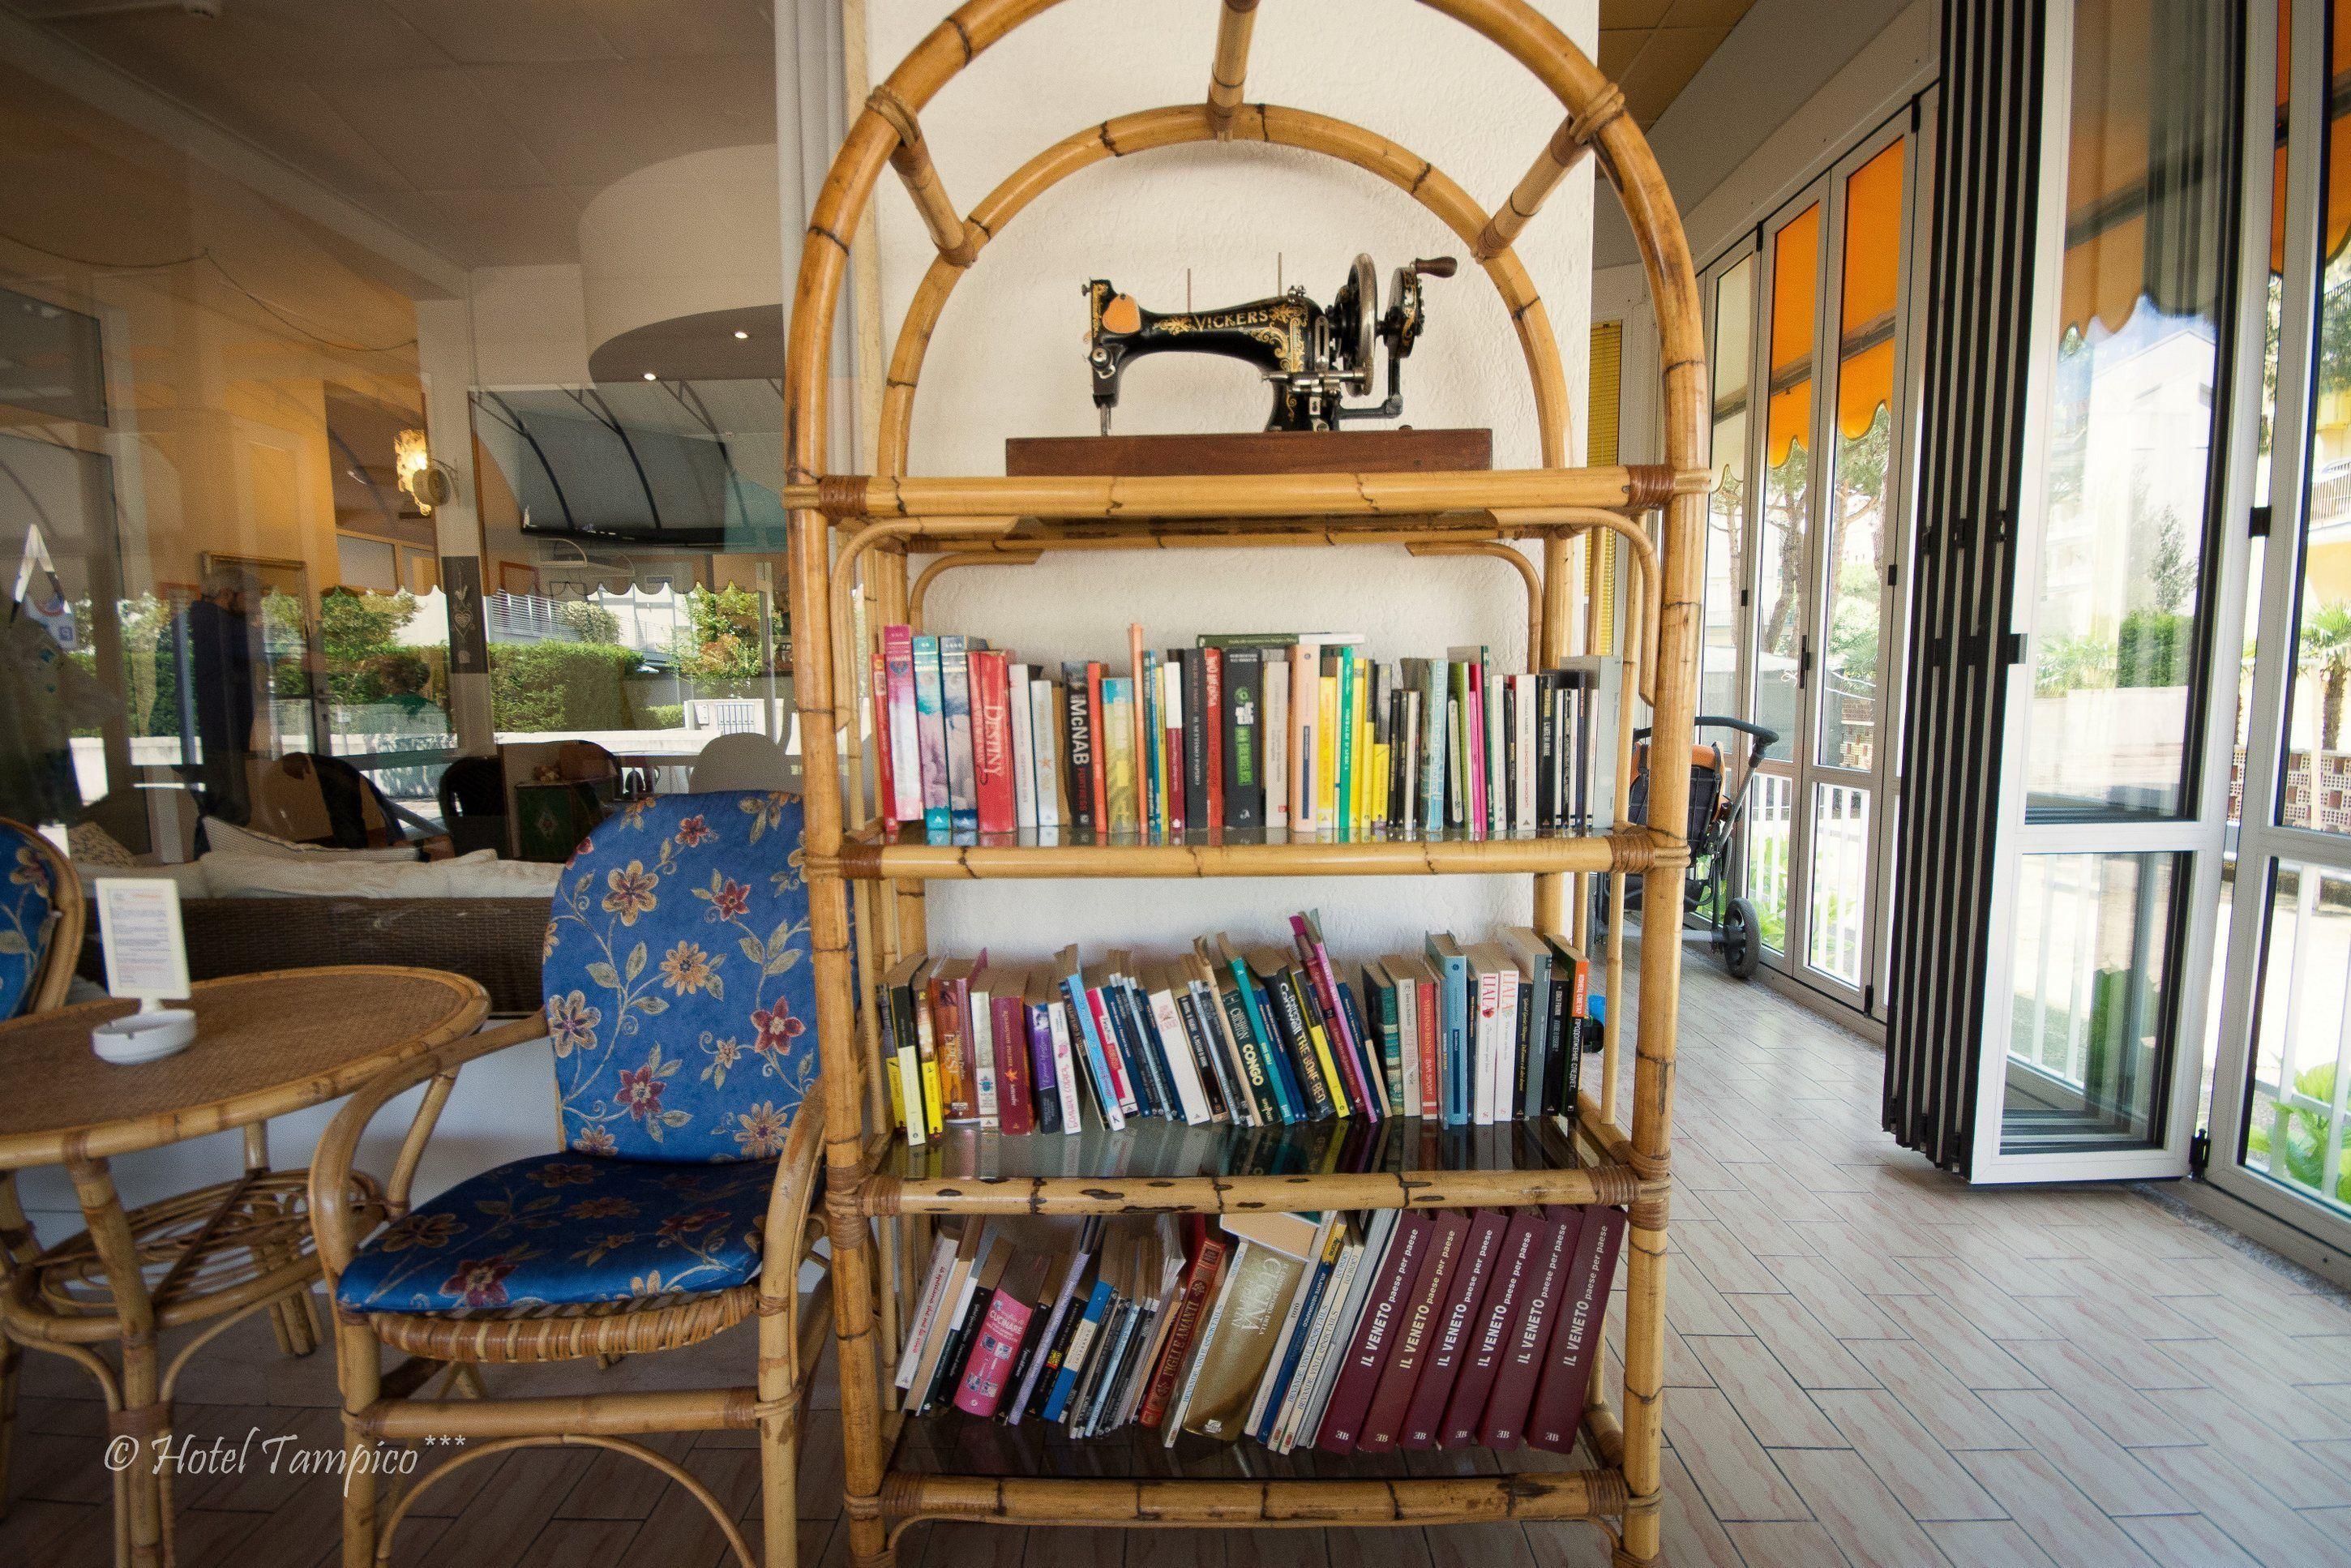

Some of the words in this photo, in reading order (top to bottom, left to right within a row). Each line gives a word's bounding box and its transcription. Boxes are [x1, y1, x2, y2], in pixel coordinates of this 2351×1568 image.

[1192, 310, 1270, 332] VICKERS
[979, 703, 1008, 778] DESTINY
[1068, 698, 1090, 765] McNAB
[1481, 975, 1497, 1014] LIALA
[1501, 972, 1516, 1013] LIALA
[1575, 973, 1585, 993] КОНЕЦ
[1278, 980, 1304, 1035] Cornwell
[1574, 992, 1583, 1014] СВЕТА?
[1294, 1030, 1311, 1055] THE
[1570, 1017, 1582, 1061] ПРОДОЛЖЕНИЕ
[1240, 1042, 1265, 1087] CONGO
[1300, 1053, 1319, 1082] BONE
[1424, 1058, 1432, 1073] BAR
[1309, 1081, 1327, 1104] BED
[1425, 1073, 1433, 1095] SPORT
[1404, 1229, 1419, 1257] paese
[1441, 1230, 1455, 1258] paese
[1479, 1229, 1493, 1257] paese
[1518, 1232, 1532, 1260] paese
[1553, 1224, 1567, 1252] paese
[1595, 1225, 1608, 1254] paese
[1398, 1257, 1408, 1275] per
[1436, 1259, 1445, 1276] per
[1473, 1257, 1483, 1275] per
[1513, 1260, 1522, 1277] per
[1549, 1253, 1558, 1270] per
[1591, 1254, 1600, 1271] per
[927, 1272, 944, 1305] speriamo
[1240, 1254, 1284, 1335] CUCINA
[1388, 1275, 1402, 1303] paese
[1426, 1277, 1440, 1305] paese
[1463, 1275, 1477, 1303] paese
[1503, 1278, 1517, 1305] paese
[1541, 1270, 1553, 1299] paese
[1584, 1272, 1597, 1300] paese
[987, 1309, 1026, 1335] CUCINARE
[1175, 1299, 1200, 1341] AMANTI
[1257, 1313, 1272, 1337] DELLA
[1301, 1294, 1317, 1328] GEOGRAFICO
[1521, 1299, 1545, 1348] VENETO
[1566, 1300, 1589, 1350] VENETO
[1365, 1302, 1392, 1351] VENETO
[1404, 1305, 1430, 1352] VENETO
[1441, 1304, 1467, 1351] VENETO
[1482, 1305, 1507, 1352] VENETO
[1171, 1338, 1185, 1349] E
[1182, 1369, 1200, 1403] BEVANDE
[1201, 1302, 1224, 1348] COCKTAILS
[1286, 1369, 1304, 1403] BEVANDE
[1307, 1303, 1329, 1347] COCKTAILS
[1161, 1347, 1182, 1378] FIGLI
[1296, 1377, 1314, 1411] BEVANDE
[1316, 1309, 1339, 1356] COCKTAILS
[1360, 1356, 1375, 1367] IL
[1399, 1358, 1413, 1369] IL
[1437, 1356, 1450, 1367] IL
[1477, 1356, 1491, 1367] IL
[1517, 1353, 1531, 1365] IL
[1563, 1356, 1577, 1366] IL
